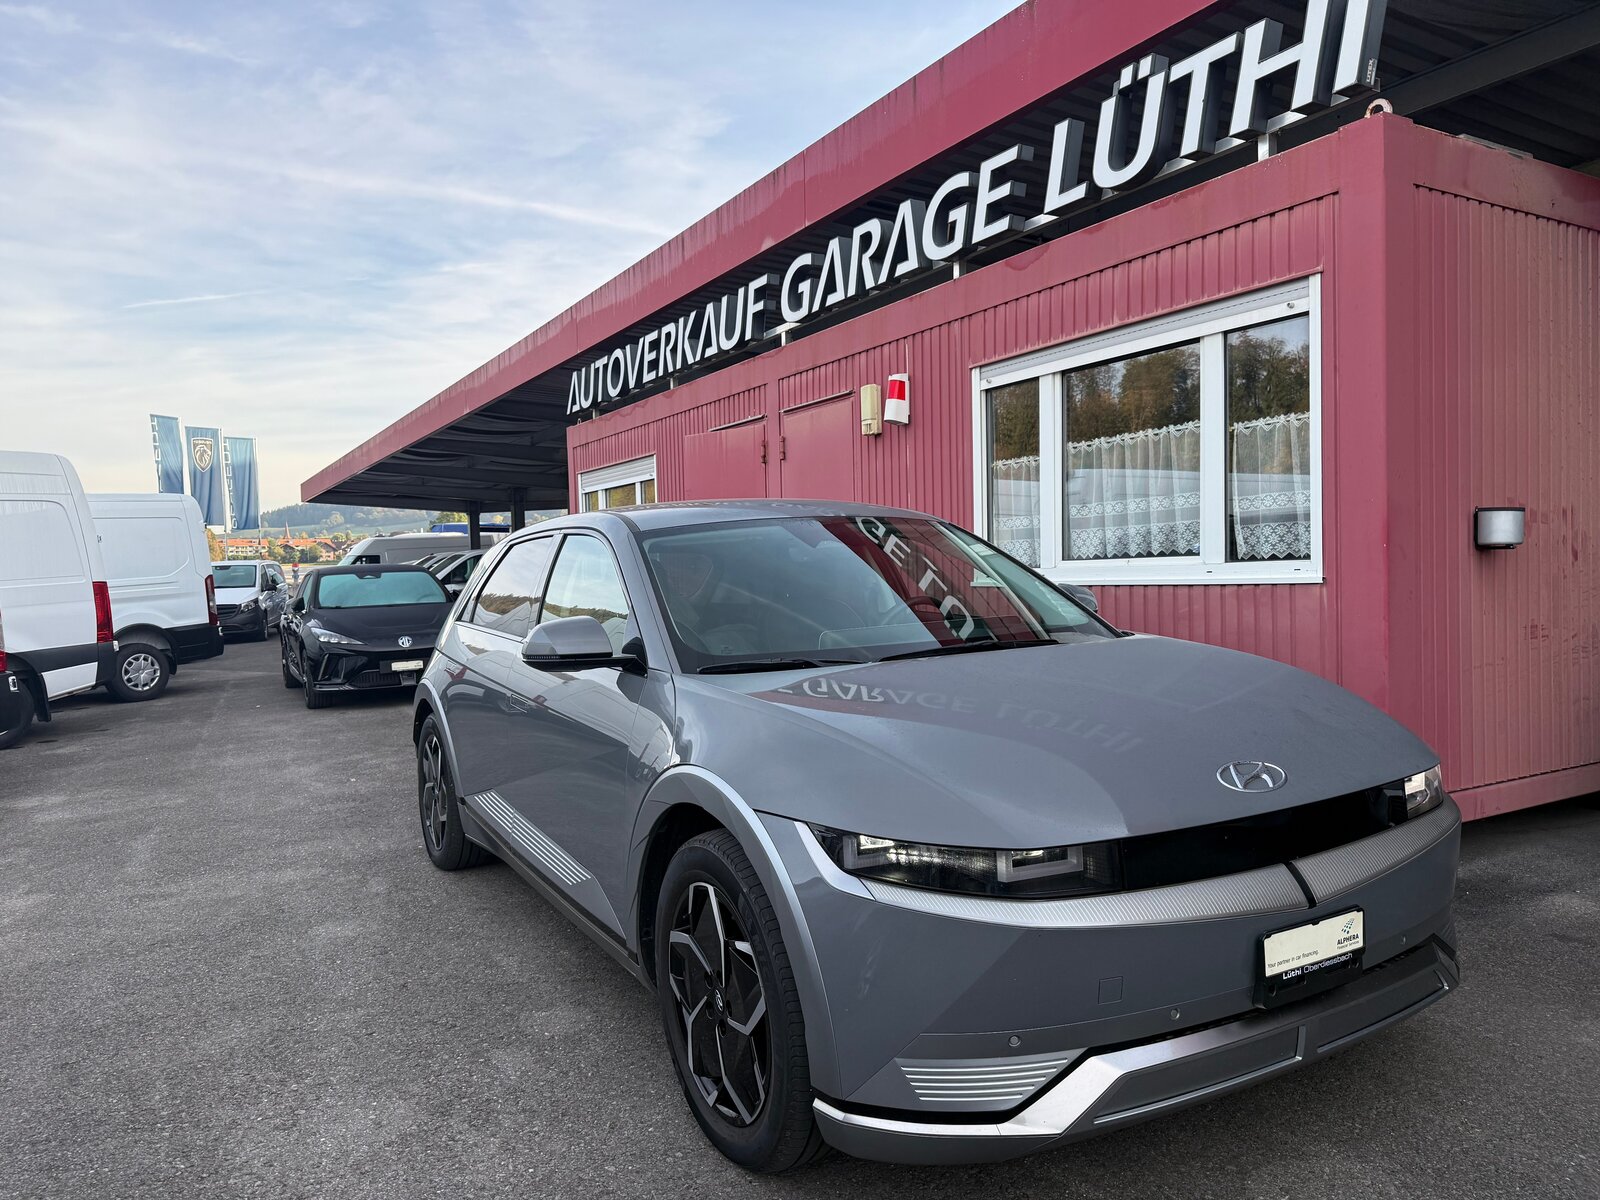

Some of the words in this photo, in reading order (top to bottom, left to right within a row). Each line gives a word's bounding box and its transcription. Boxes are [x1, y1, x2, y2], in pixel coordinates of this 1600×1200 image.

[566, 273, 769, 415] AUTOVERKAUF
[781, 144, 1023, 323] GARAGE
[1044, 0, 1370, 214] LÜTHI
[398, 636, 412, 648] MG
[1336, 933, 1360, 946] ALPHERA
[1282, 967, 1302, 980] Lüthi
